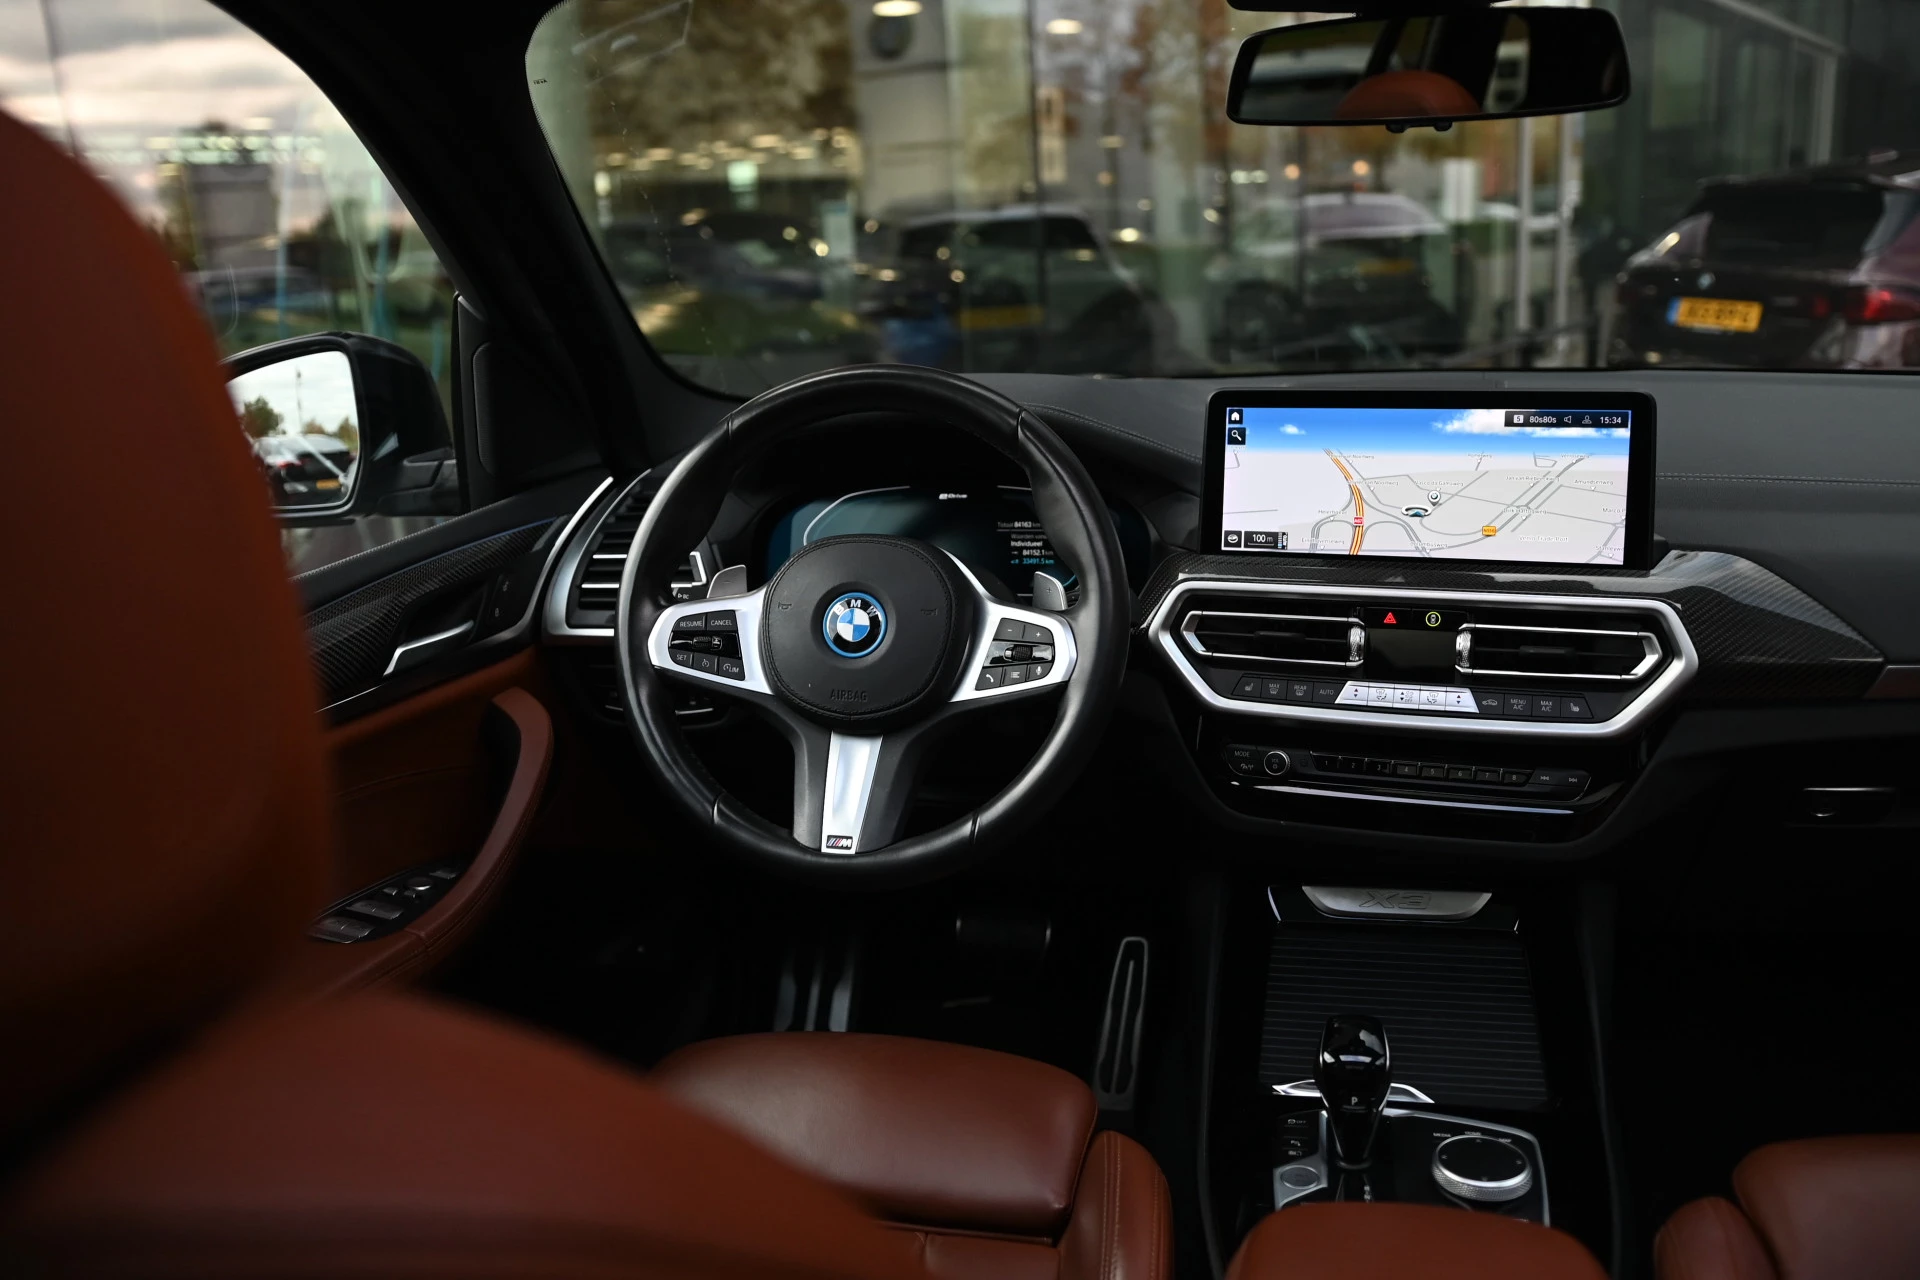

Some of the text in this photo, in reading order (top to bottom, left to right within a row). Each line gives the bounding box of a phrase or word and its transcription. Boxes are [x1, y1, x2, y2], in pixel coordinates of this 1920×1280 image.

[1530, 416, 1556, 424] 80s80s
[1600, 416, 1622, 424] 15:34
[1252, 534, 1266, 542] 100
[833, 599, 878, 617] BMW
[830, 688, 868, 701] AIRBAG
[1359, 891, 1432, 909] X3
[1351, 1096, 1358, 1106] P
